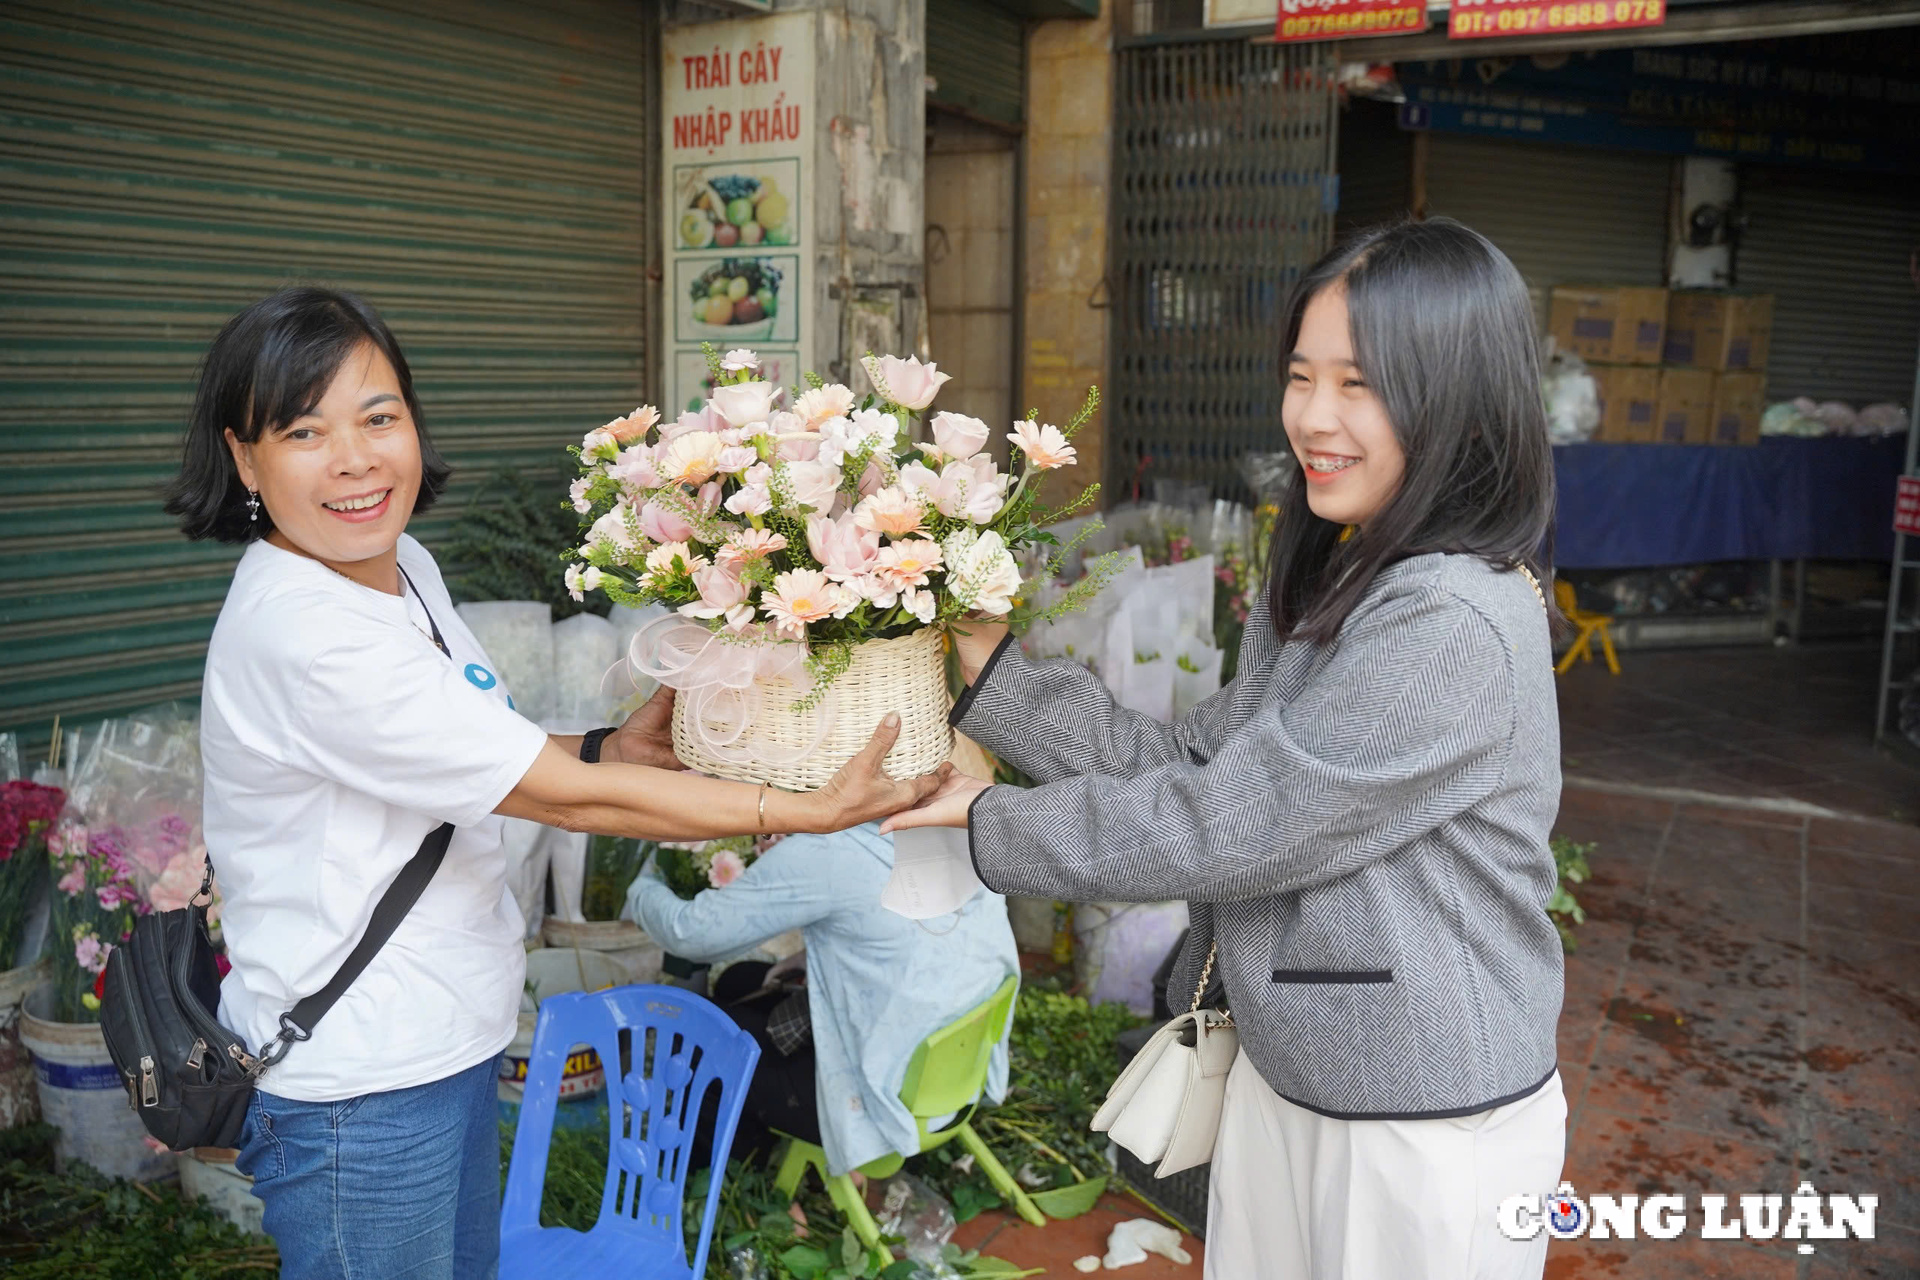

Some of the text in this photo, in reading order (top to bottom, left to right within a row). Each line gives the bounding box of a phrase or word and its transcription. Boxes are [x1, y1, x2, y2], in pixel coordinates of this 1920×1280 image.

[1498, 8, 1541, 31] 097
[1548, 4, 1607, 28] 6688
[1615, 0, 1660, 23] 078
[683, 41, 783, 91] TRÁI CÂY
[673, 90, 800, 155] NHẬP KHẨU
